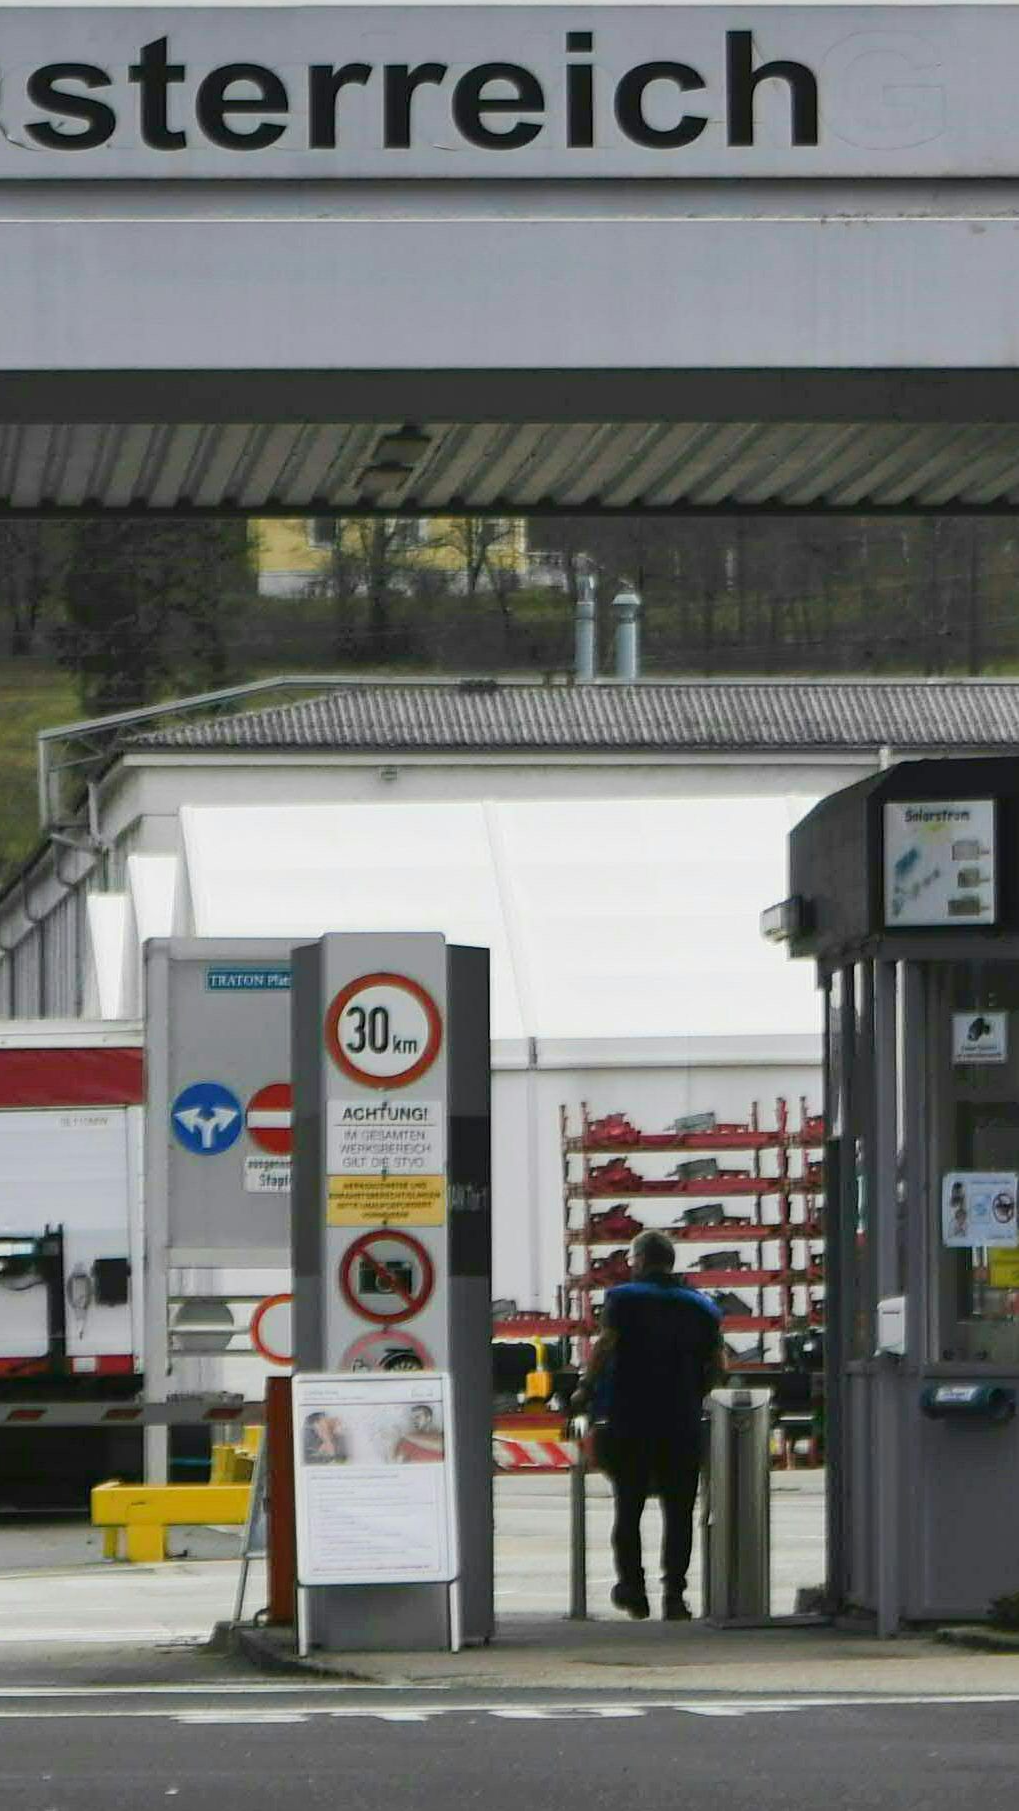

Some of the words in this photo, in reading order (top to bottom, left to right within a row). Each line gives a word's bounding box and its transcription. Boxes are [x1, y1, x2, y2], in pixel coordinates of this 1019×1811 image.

[346, 1005, 389, 1055] 30
[392, 1034, 418, 1055] km
[342, 1107, 429, 1121] ACHTUNG!
[363, 1130, 426, 1142] GESAMTEN
